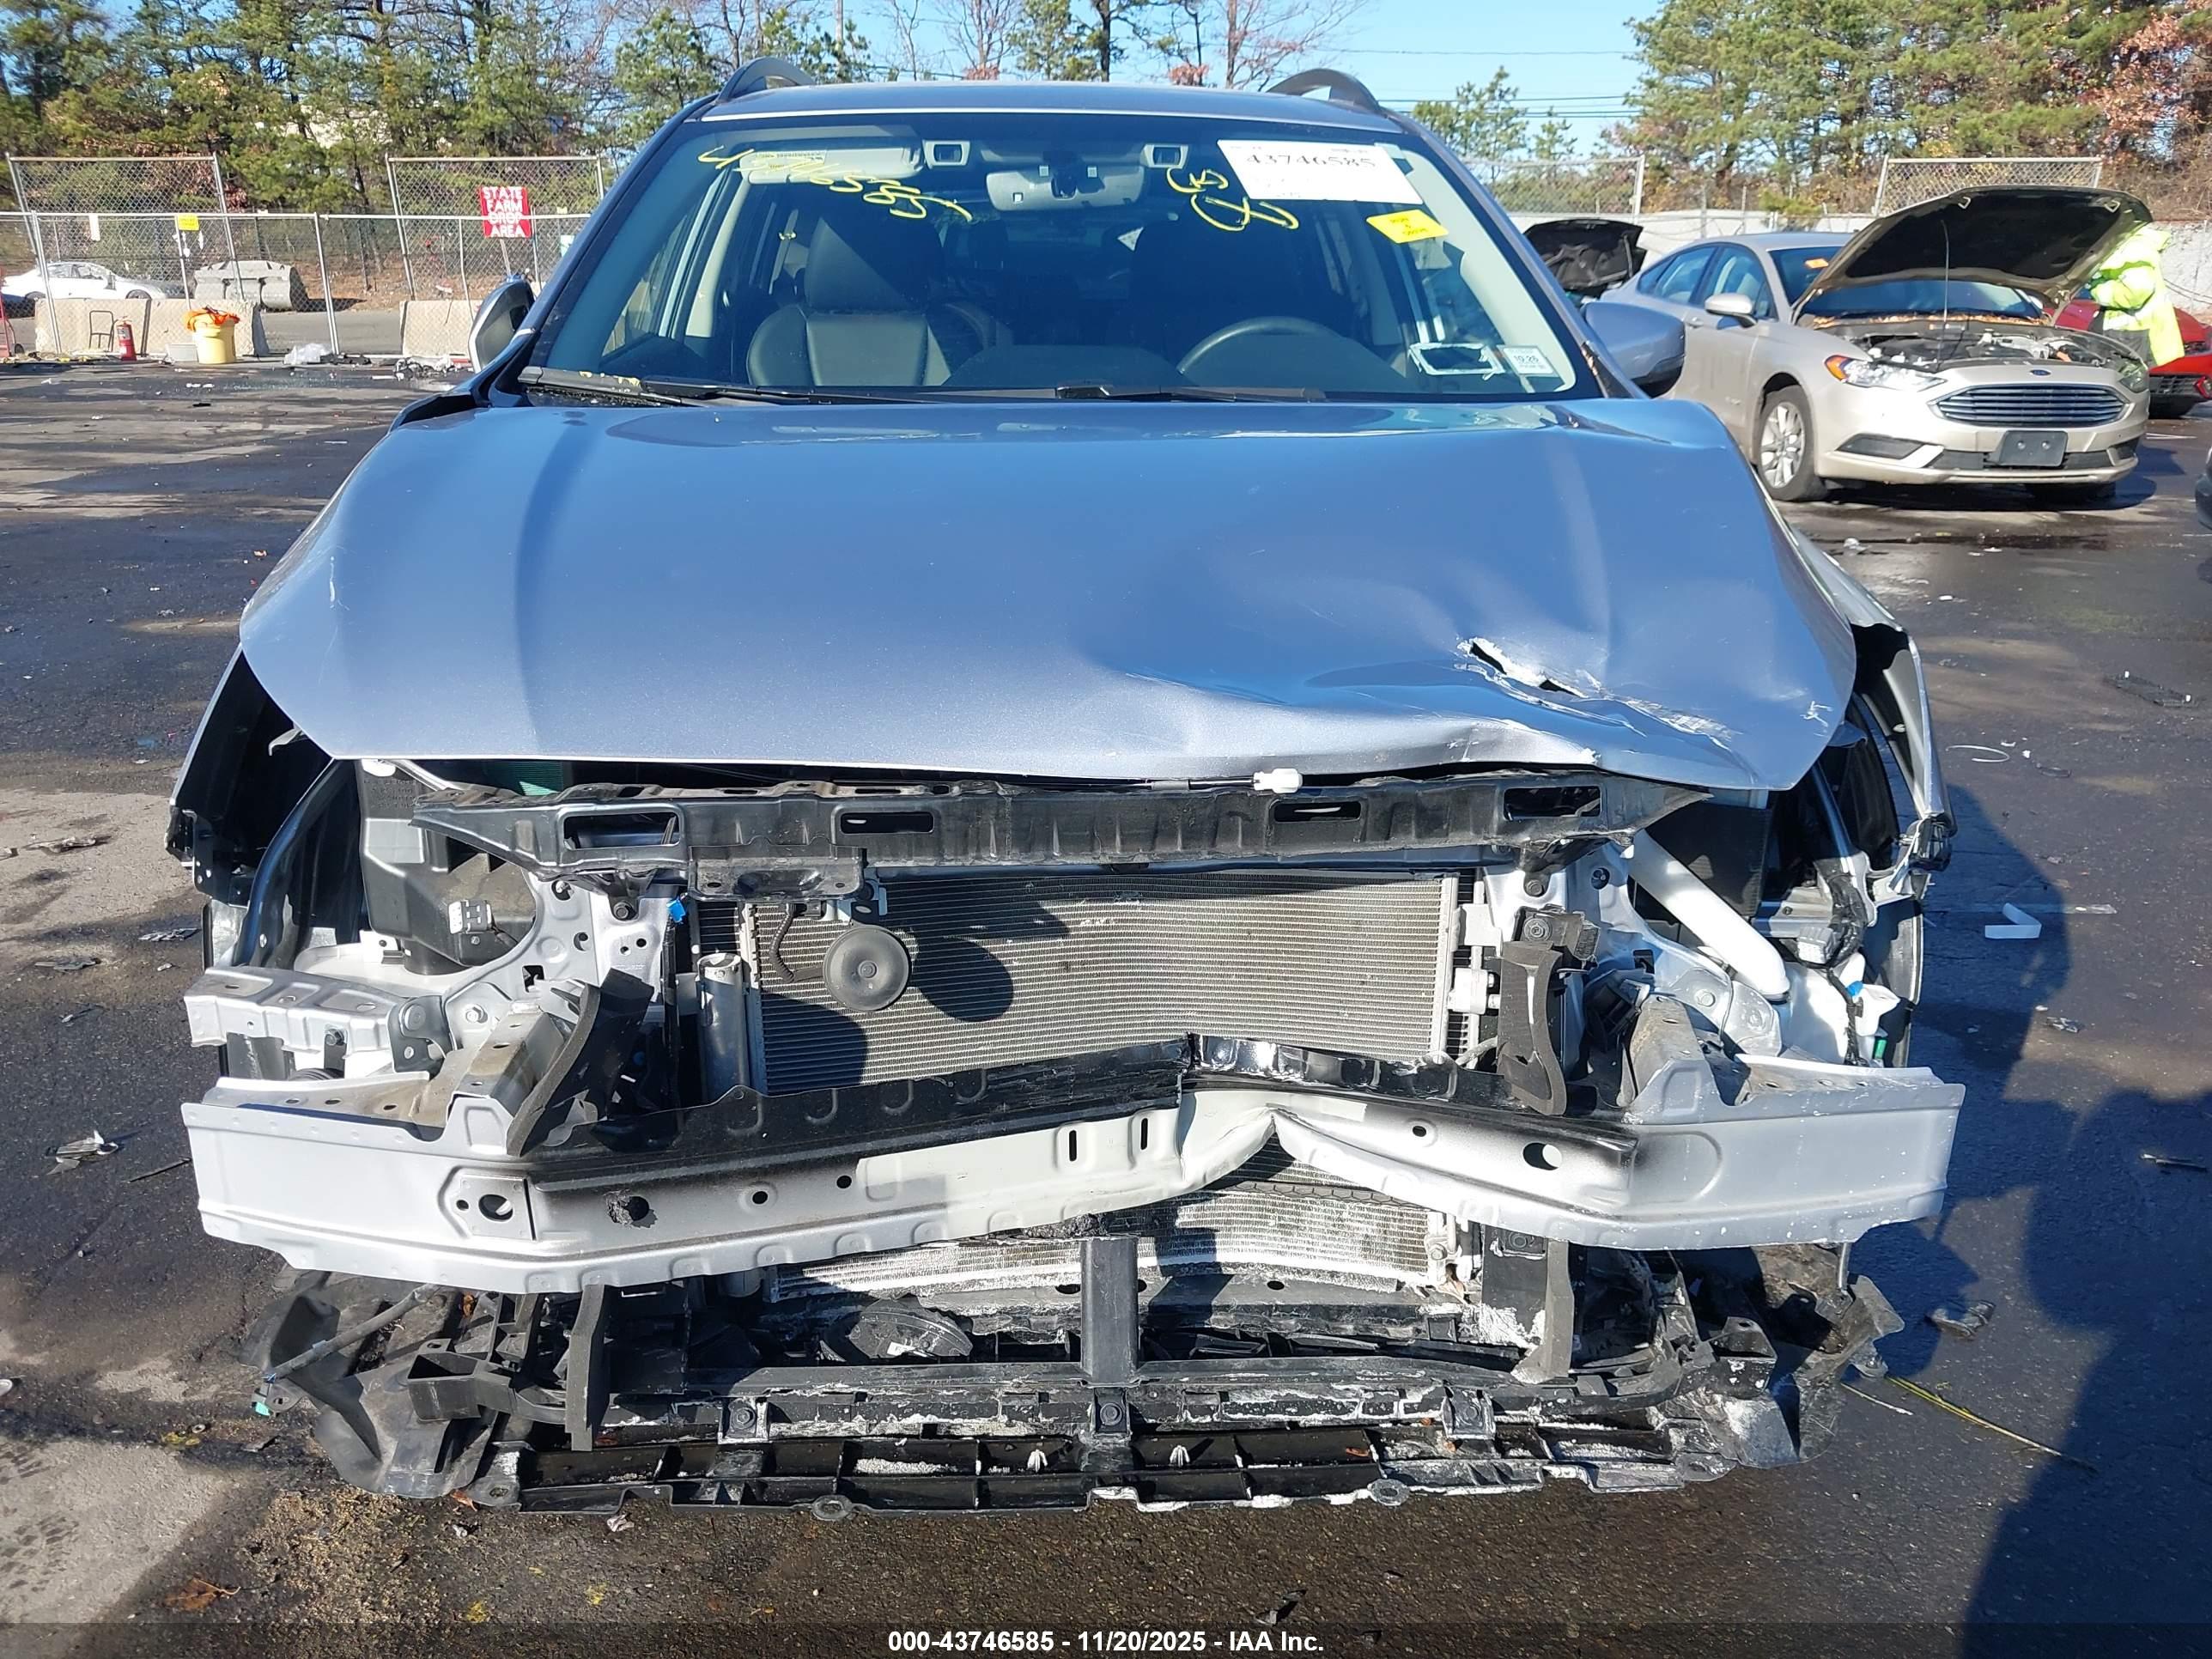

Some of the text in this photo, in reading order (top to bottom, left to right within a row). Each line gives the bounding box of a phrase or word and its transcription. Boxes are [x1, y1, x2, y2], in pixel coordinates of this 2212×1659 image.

[1246, 153, 1376, 168] 43746585
[482, 186, 523, 200] STATE
[486, 199, 524, 213] FARM
[488, 211, 523, 225] DROP
[490, 224, 526, 238] AREA
